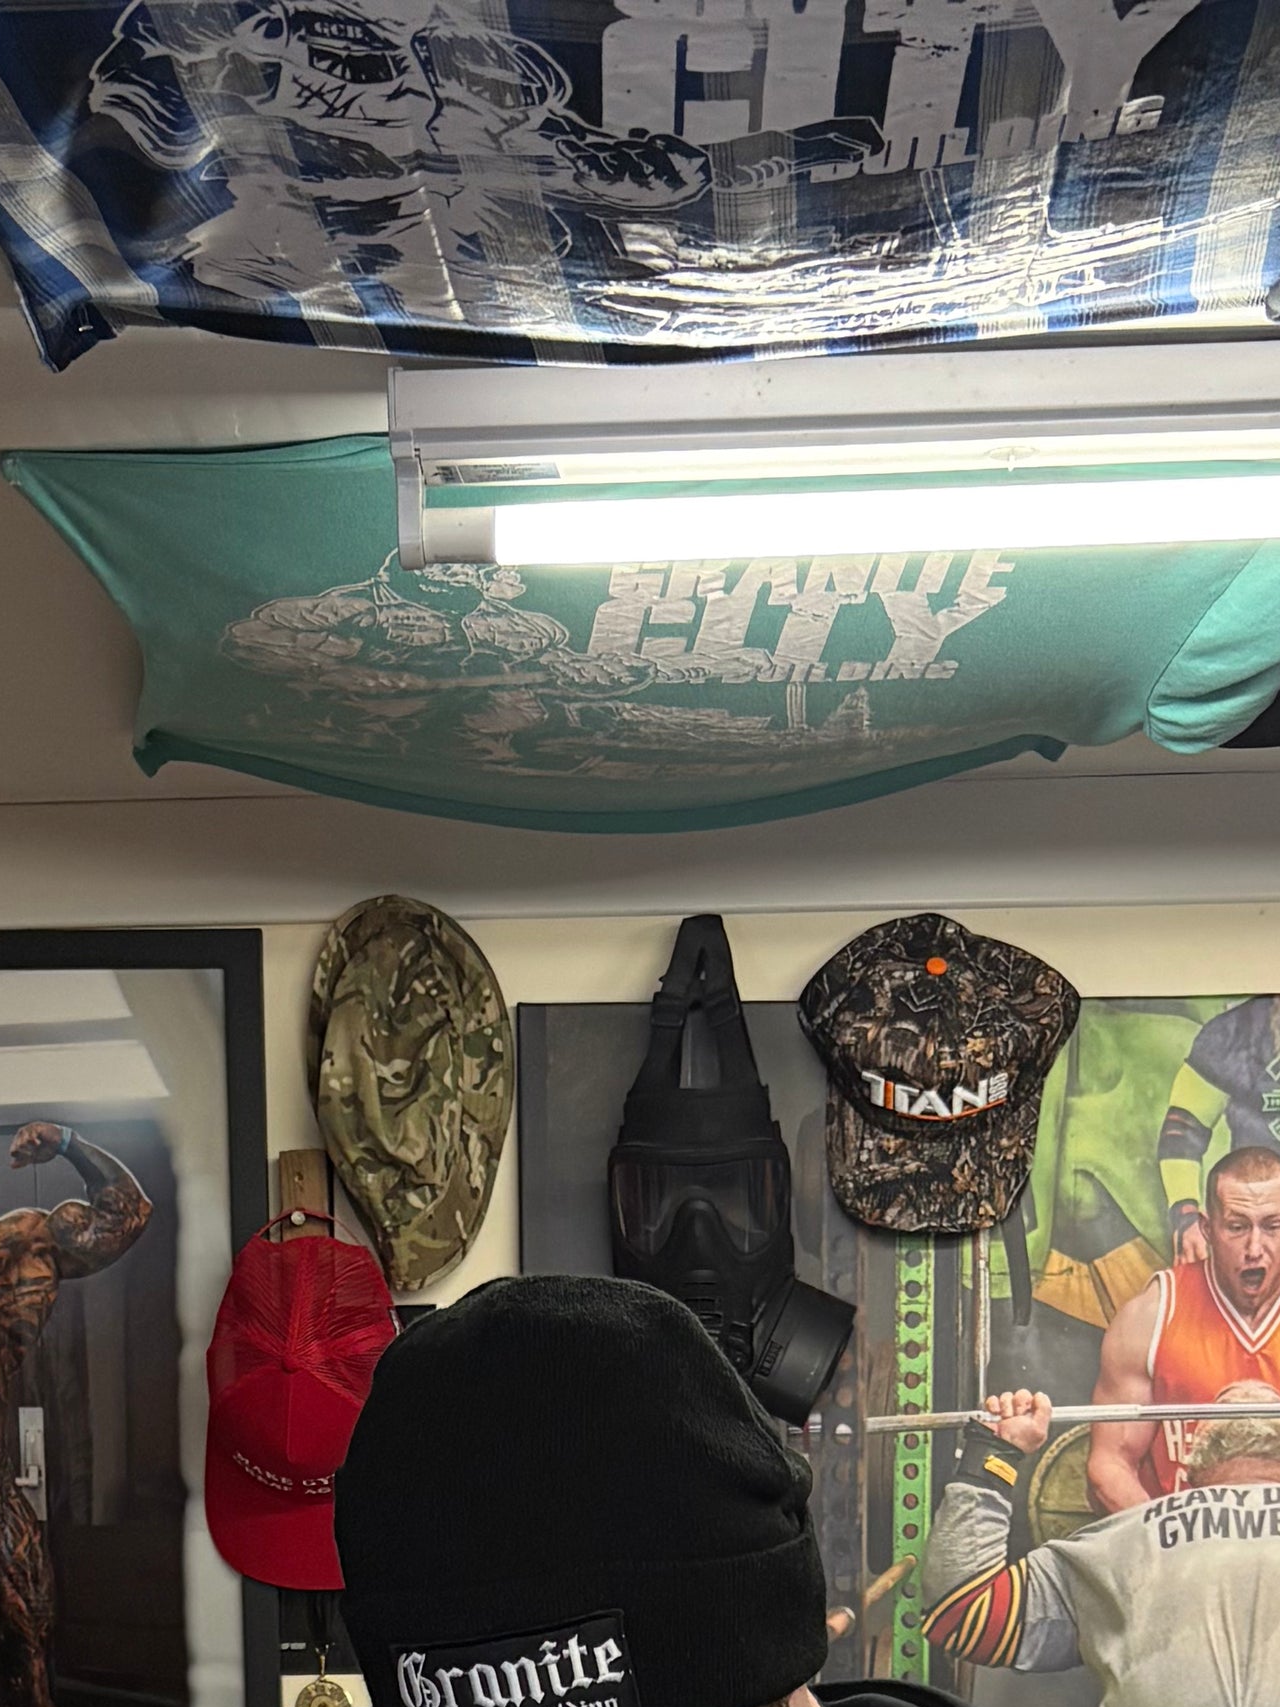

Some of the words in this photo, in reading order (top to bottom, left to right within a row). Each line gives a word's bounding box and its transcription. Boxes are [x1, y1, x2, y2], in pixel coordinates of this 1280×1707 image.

[861, 1071, 997, 1118] TITAN
[233, 1452, 293, 1485] MAKE
[1144, 1487, 1251, 1524] HEAVY
